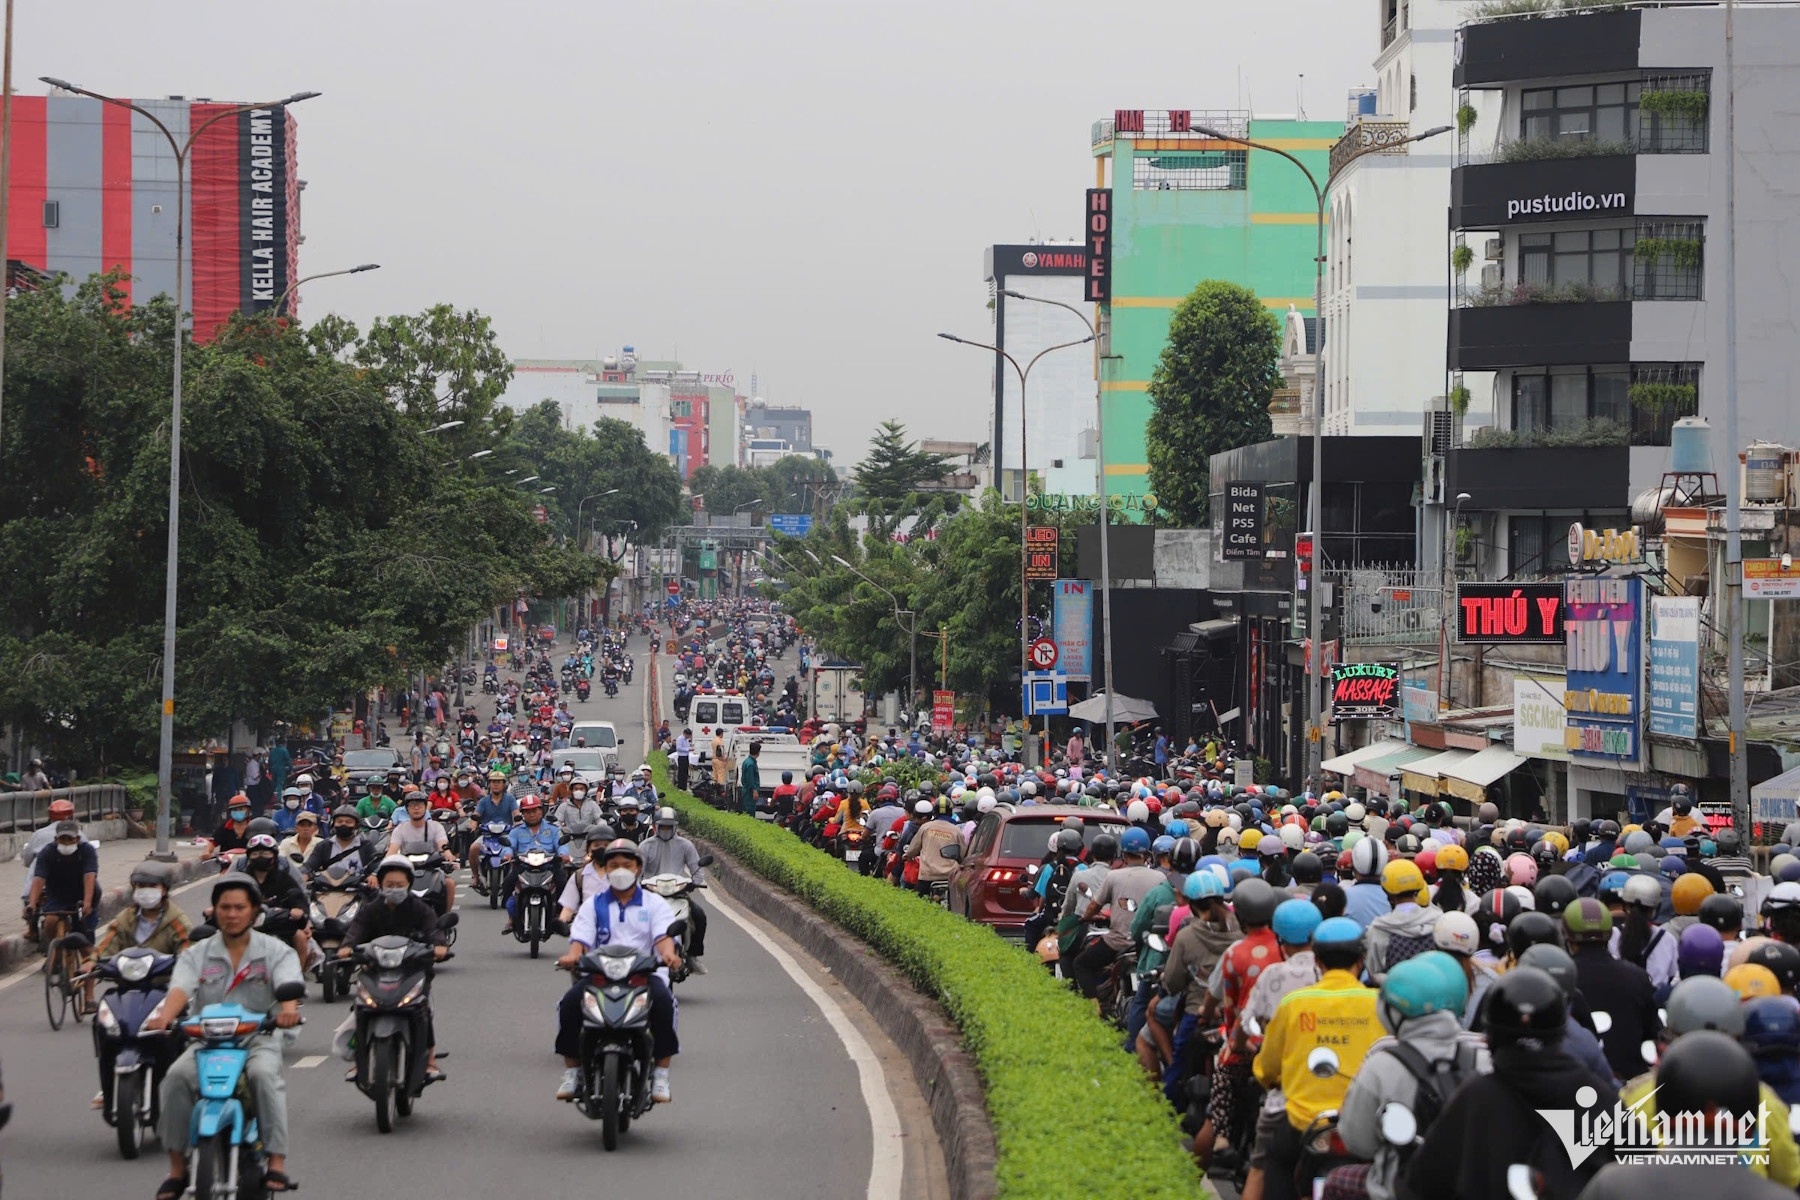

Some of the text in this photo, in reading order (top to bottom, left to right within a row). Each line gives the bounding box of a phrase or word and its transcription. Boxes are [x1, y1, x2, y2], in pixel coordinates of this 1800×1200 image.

[251, 108, 274, 301] KELLA HAIR ACADEMY
[1507, 191, 1626, 219] pustudio.vn
[1091, 193, 1107, 298] HOTEL
[1231, 487, 1257, 497] Bida
[1232, 503, 1255, 513] Net
[1232, 518, 1255, 528] PS5
[1027, 529, 1056, 542] LED
[1230, 533, 1257, 544] Cafe
[1246, 548, 1260, 556] Tâm
[1032, 554, 1051, 567] IN
[1063, 583, 1084, 594] IN
[1461, 590, 1559, 635] THÚ Y
[1563, 609, 1632, 673] THÚ Y
[1334, 665, 1397, 681] LUXURY
[1334, 678, 1397, 706] MASSAGE
[1316, 1036, 1350, 1045] M&E
